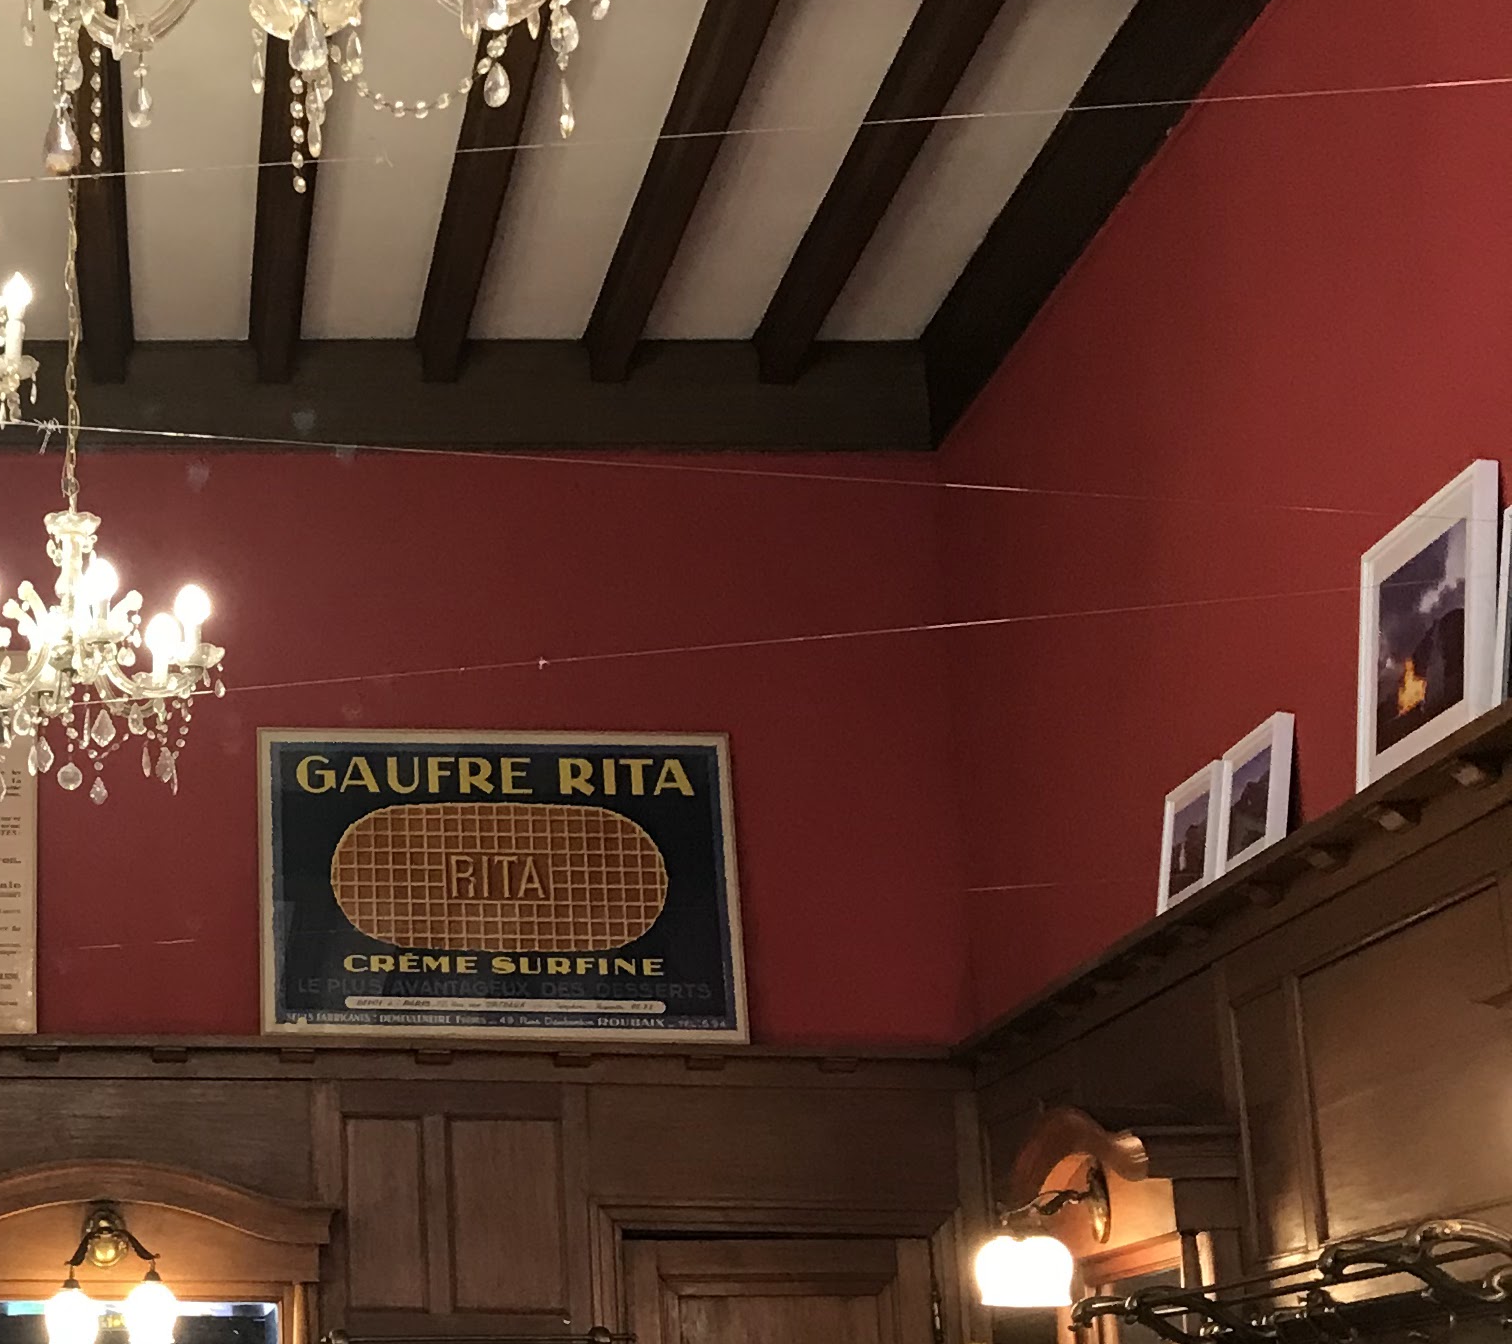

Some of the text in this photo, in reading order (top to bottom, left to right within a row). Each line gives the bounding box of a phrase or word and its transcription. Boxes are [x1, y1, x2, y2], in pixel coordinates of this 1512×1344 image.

[296, 754, 696, 797] GAUFRE RITA
[449, 854, 548, 900] RITA
[491, 955, 665, 976] SURFINE
[298, 978, 713, 1000] LE PLUS AVANTAGEUX DES DESSERTS
[597, 1017, 665, 1028] ROUBAIX
